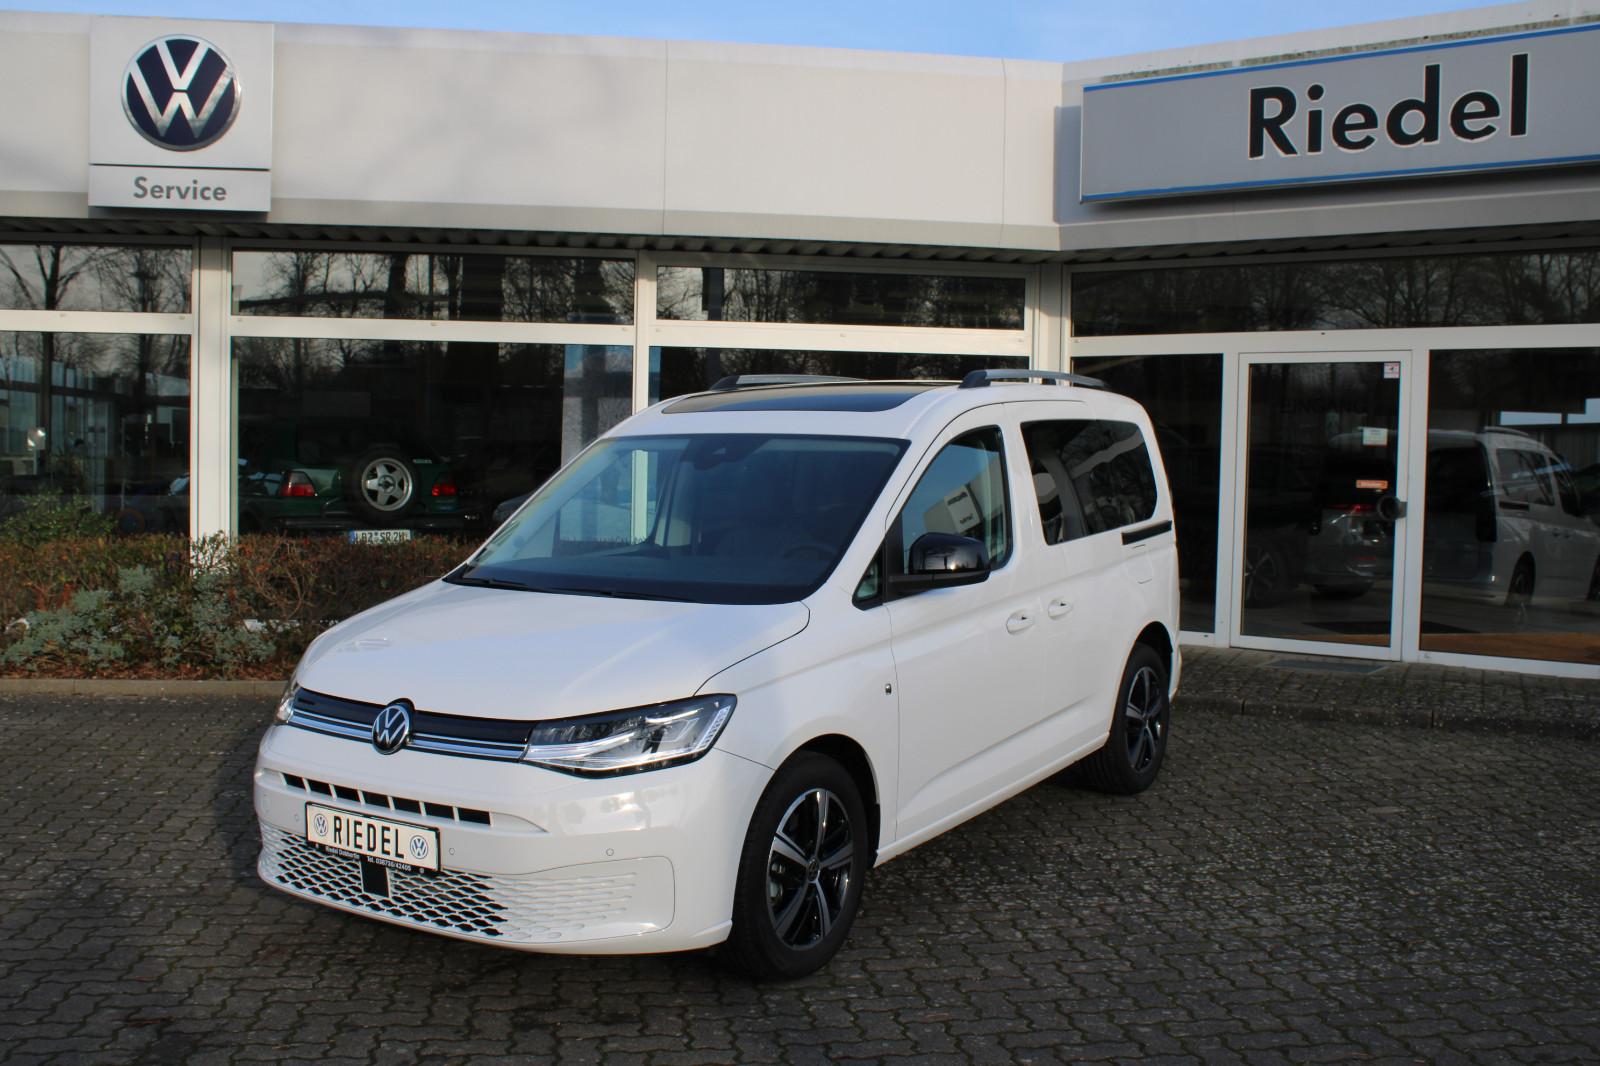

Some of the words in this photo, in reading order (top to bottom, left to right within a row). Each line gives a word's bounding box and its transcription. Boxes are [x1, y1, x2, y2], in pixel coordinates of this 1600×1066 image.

[1249, 53, 1528, 159] Riedel
[133, 176, 227, 201] Service
[333, 815, 405, 859] RIEDEL
